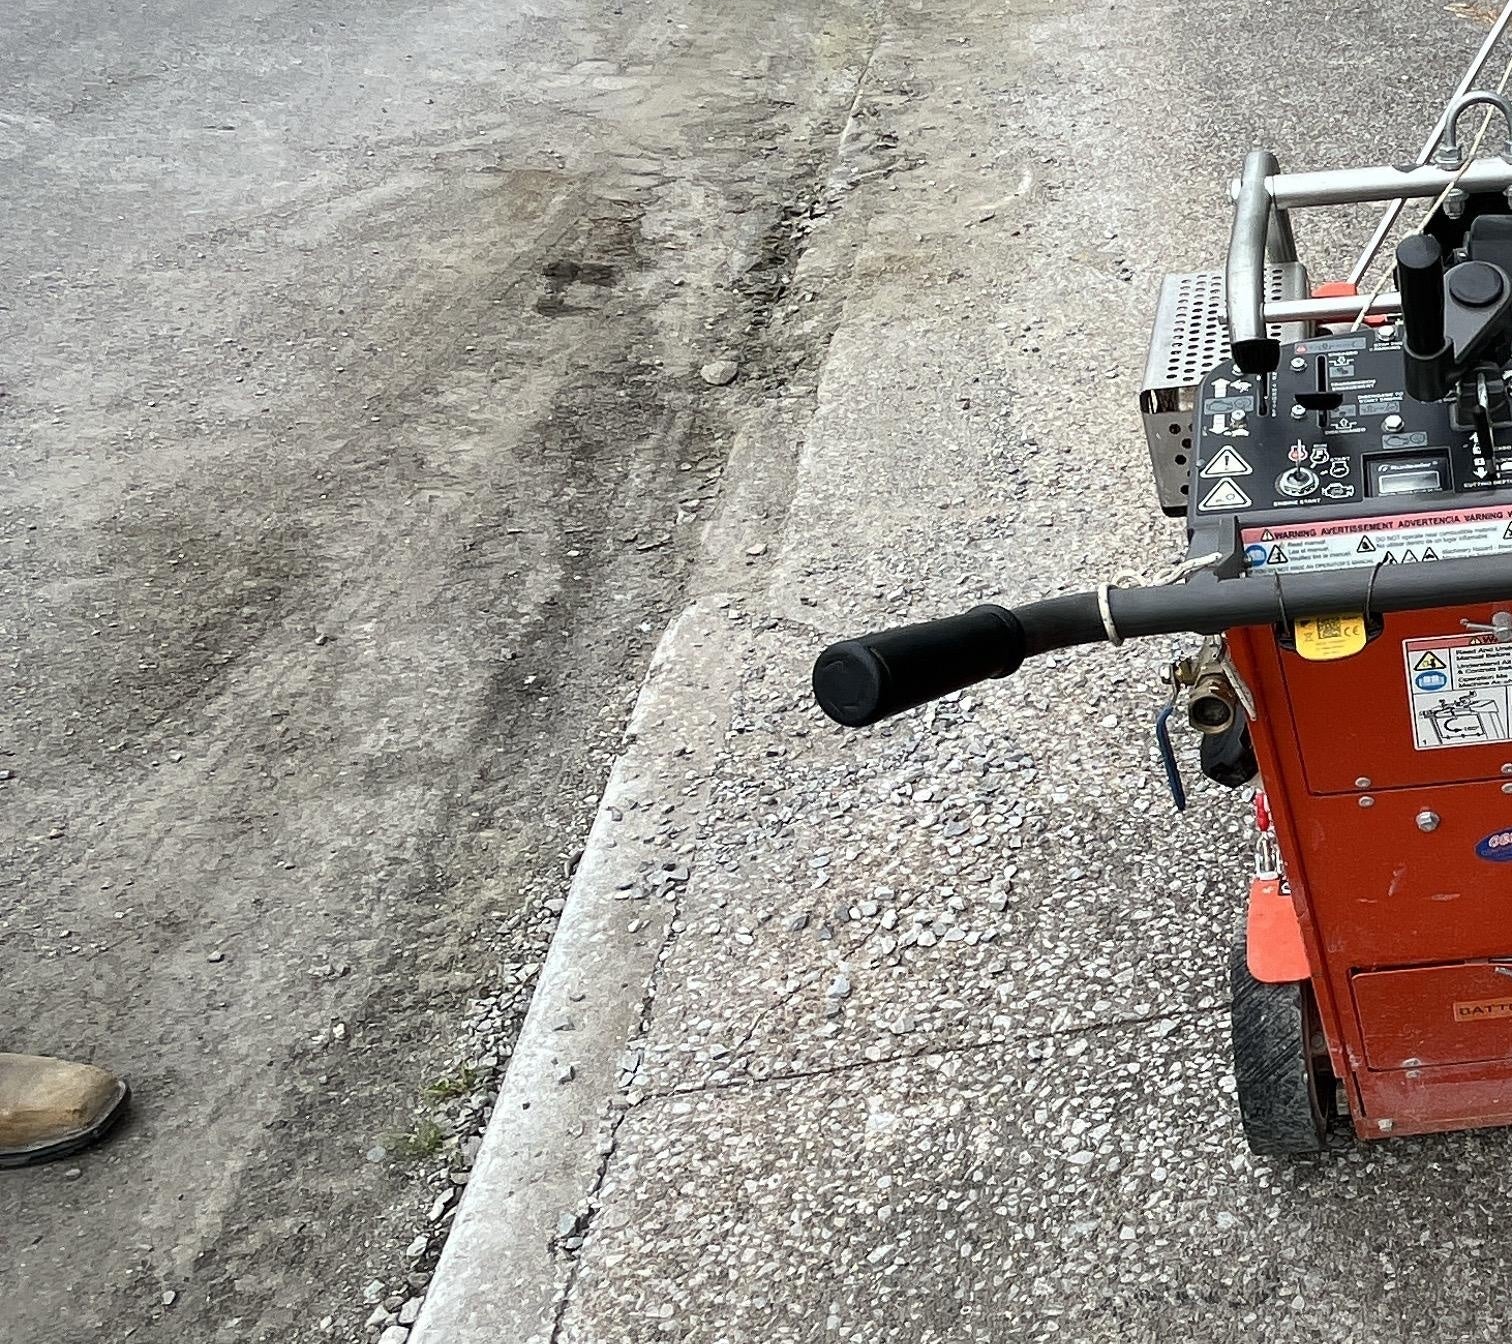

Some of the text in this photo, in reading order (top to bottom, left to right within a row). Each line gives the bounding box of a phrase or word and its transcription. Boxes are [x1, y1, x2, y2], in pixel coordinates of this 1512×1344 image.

[1274, 529, 1317, 540] WARNING
[1321, 522, 1394, 536] AVERTISSEMENT
[1398, 516, 1460, 528] ADVERTENCIA
[1464, 511, 1503, 522] VARNING
